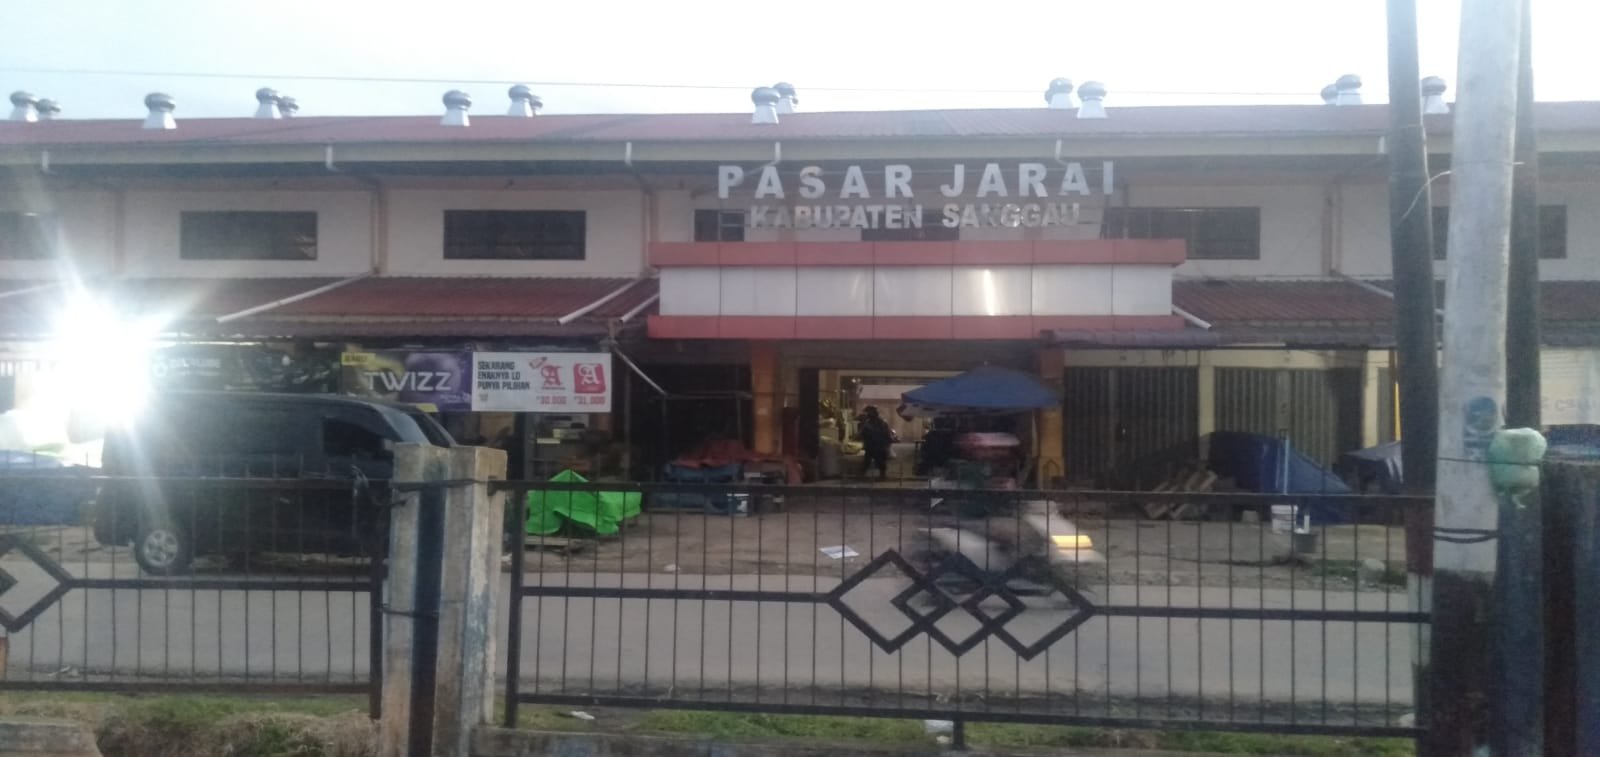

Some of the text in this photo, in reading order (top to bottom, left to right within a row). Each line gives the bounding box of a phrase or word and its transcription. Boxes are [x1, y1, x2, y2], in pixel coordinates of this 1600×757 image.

[717, 160, 1114, 200] PASAR JARAI
[750, 204, 923, 230] KABUPATEN
[477, 361, 515, 370] SEKARANG
[365, 371, 452, 391] TWIZZ
[477, 371, 509, 380] ENAKNYA
[477, 381, 530, 390] PUNYA PILIHAN
